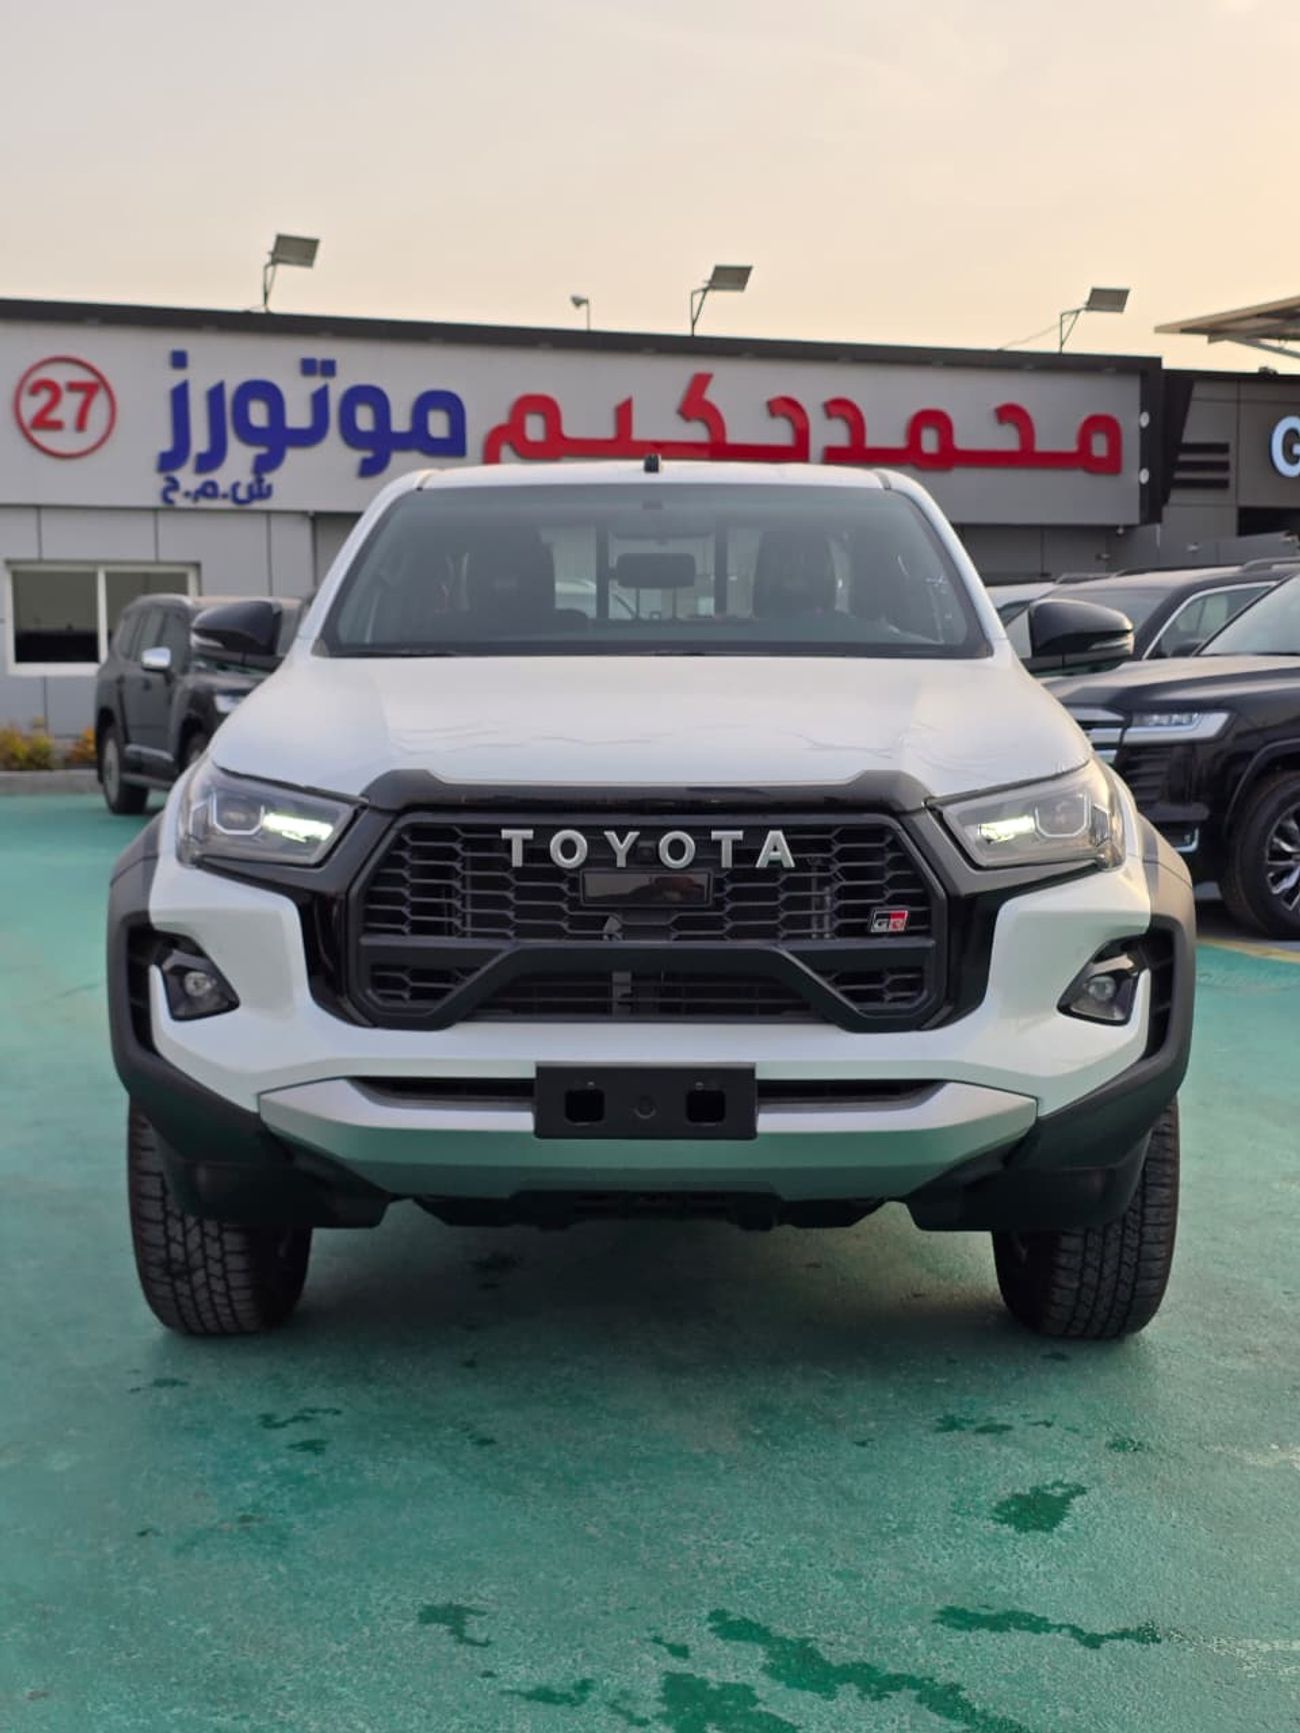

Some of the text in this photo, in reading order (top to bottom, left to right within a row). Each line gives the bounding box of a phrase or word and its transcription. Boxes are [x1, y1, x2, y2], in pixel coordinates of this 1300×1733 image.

[27, 379, 100, 432] 27
[156, 349, 467, 478] موتورز
[823, 396, 1124, 475] محمد
[501, 828, 796, 870] TOYOTA
